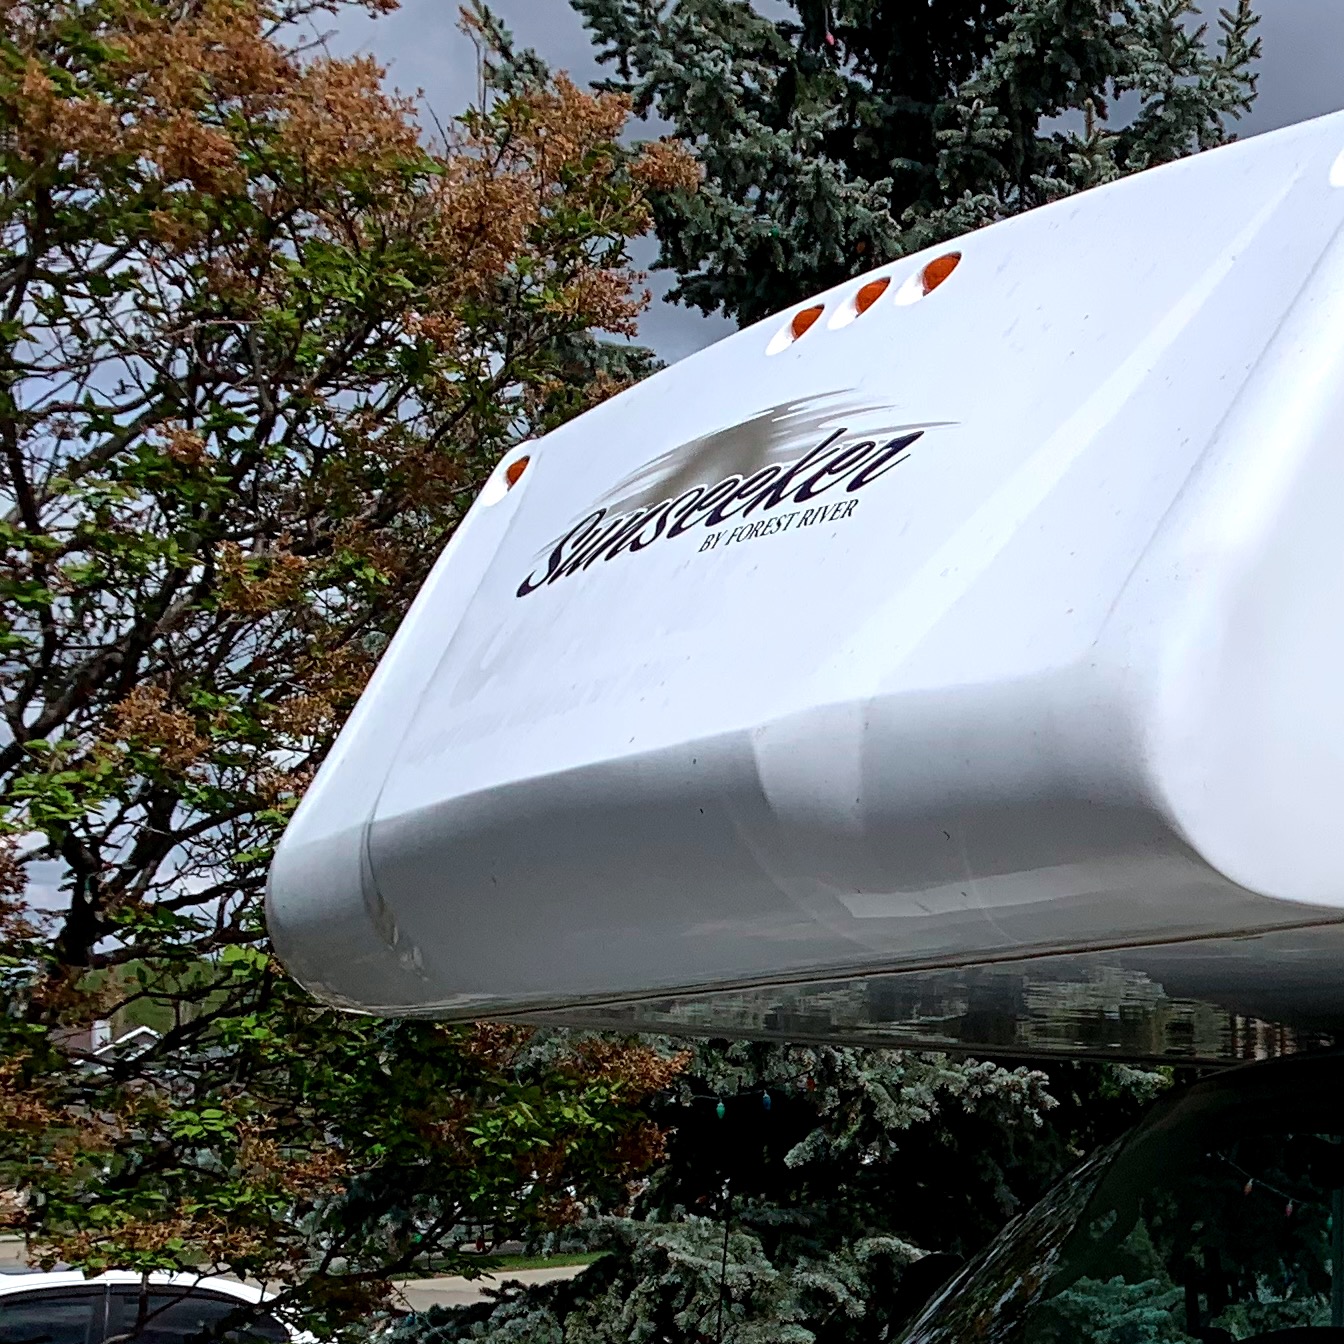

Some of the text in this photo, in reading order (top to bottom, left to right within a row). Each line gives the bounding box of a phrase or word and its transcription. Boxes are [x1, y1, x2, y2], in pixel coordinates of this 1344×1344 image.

[516, 427, 924, 598] Sunseeker
[698, 499, 859, 553] BY FOREST RIVER
